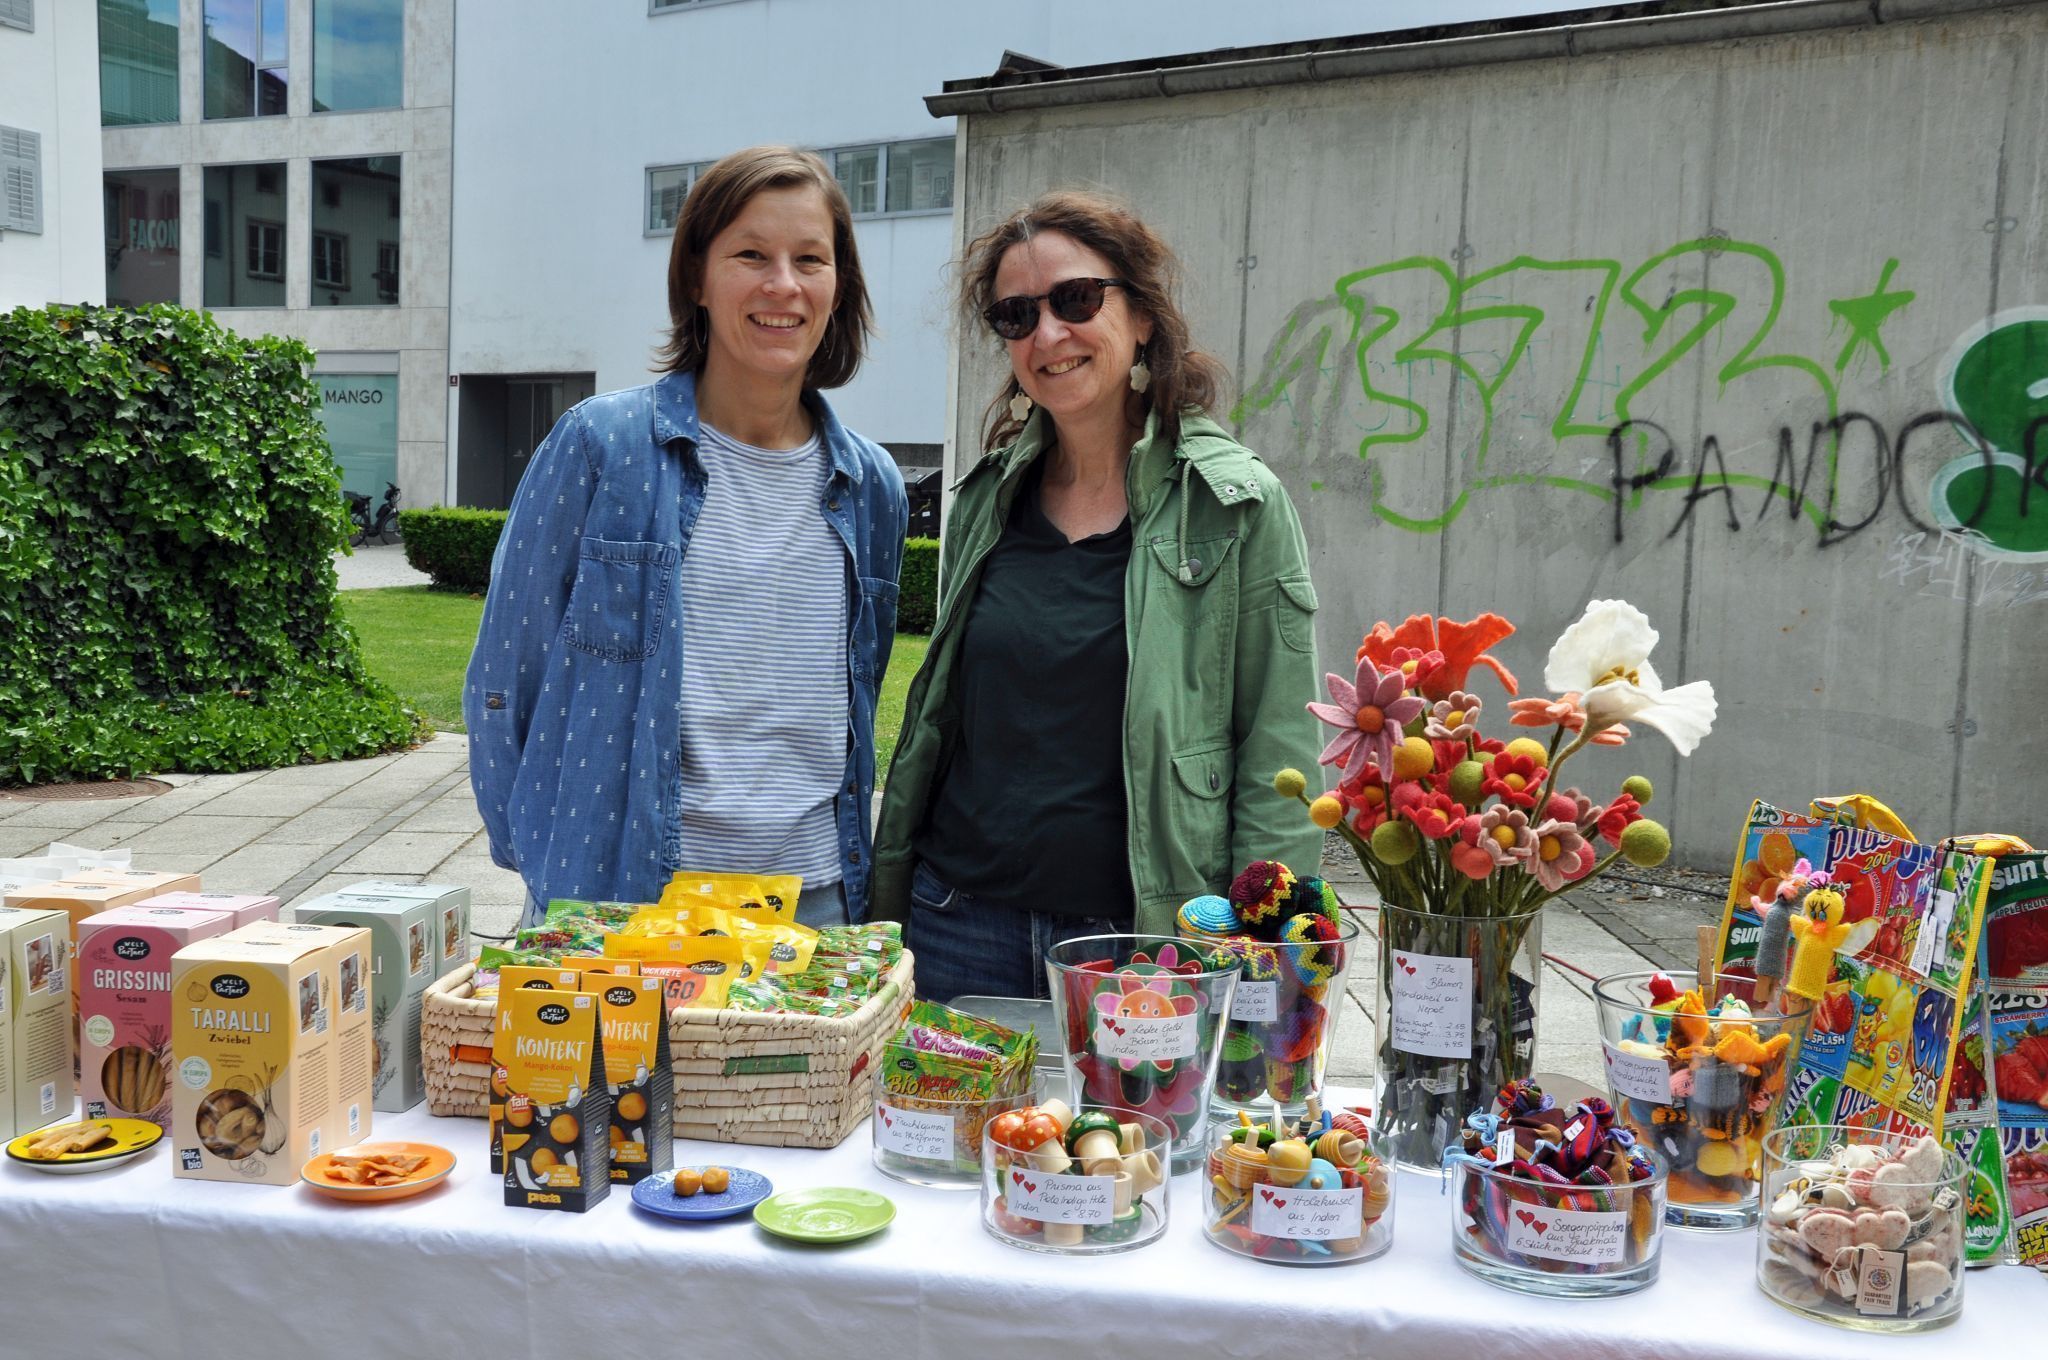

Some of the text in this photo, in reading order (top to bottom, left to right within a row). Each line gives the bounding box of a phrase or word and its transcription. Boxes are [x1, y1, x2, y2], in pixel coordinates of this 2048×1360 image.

[325, 390, 383, 404] MANGO
[1990, 859, 2037, 891] sun
[117, 946, 148, 957] Partner
[641, 966, 683, 978] ROCKNETE
[93, 968, 172, 992] GRISSINI
[215, 983, 246, 995] Partner
[608, 994, 634, 1004] Partner
[190, 1007, 271, 1034] TARALLI
[541, 1012, 567, 1022] Partner
[1993, 1010, 2046, 1024] STRAWBERRY
[604, 1019, 652, 1042] NFEKT
[209, 1033, 252, 1045] Zwiebel
[1811, 1033, 1845, 1046] SPLASH
[516, 1034, 587, 1062] KONFEKT
[496, 1067, 507, 1079] fa
[511, 1095, 529, 1106] fair
[188, 1159, 202, 1170] bio
[1044, 1178, 1102, 1191] Prisma aus
[1292, 1194, 1355, 1207] Holzkreisel
[1061, 1209, 1071, 1219] €
[1287, 1211, 1341, 1223] aus Indien
[1287, 1227, 1331, 1236] € 3.50
[1546, 1232, 1564, 1242] aus
